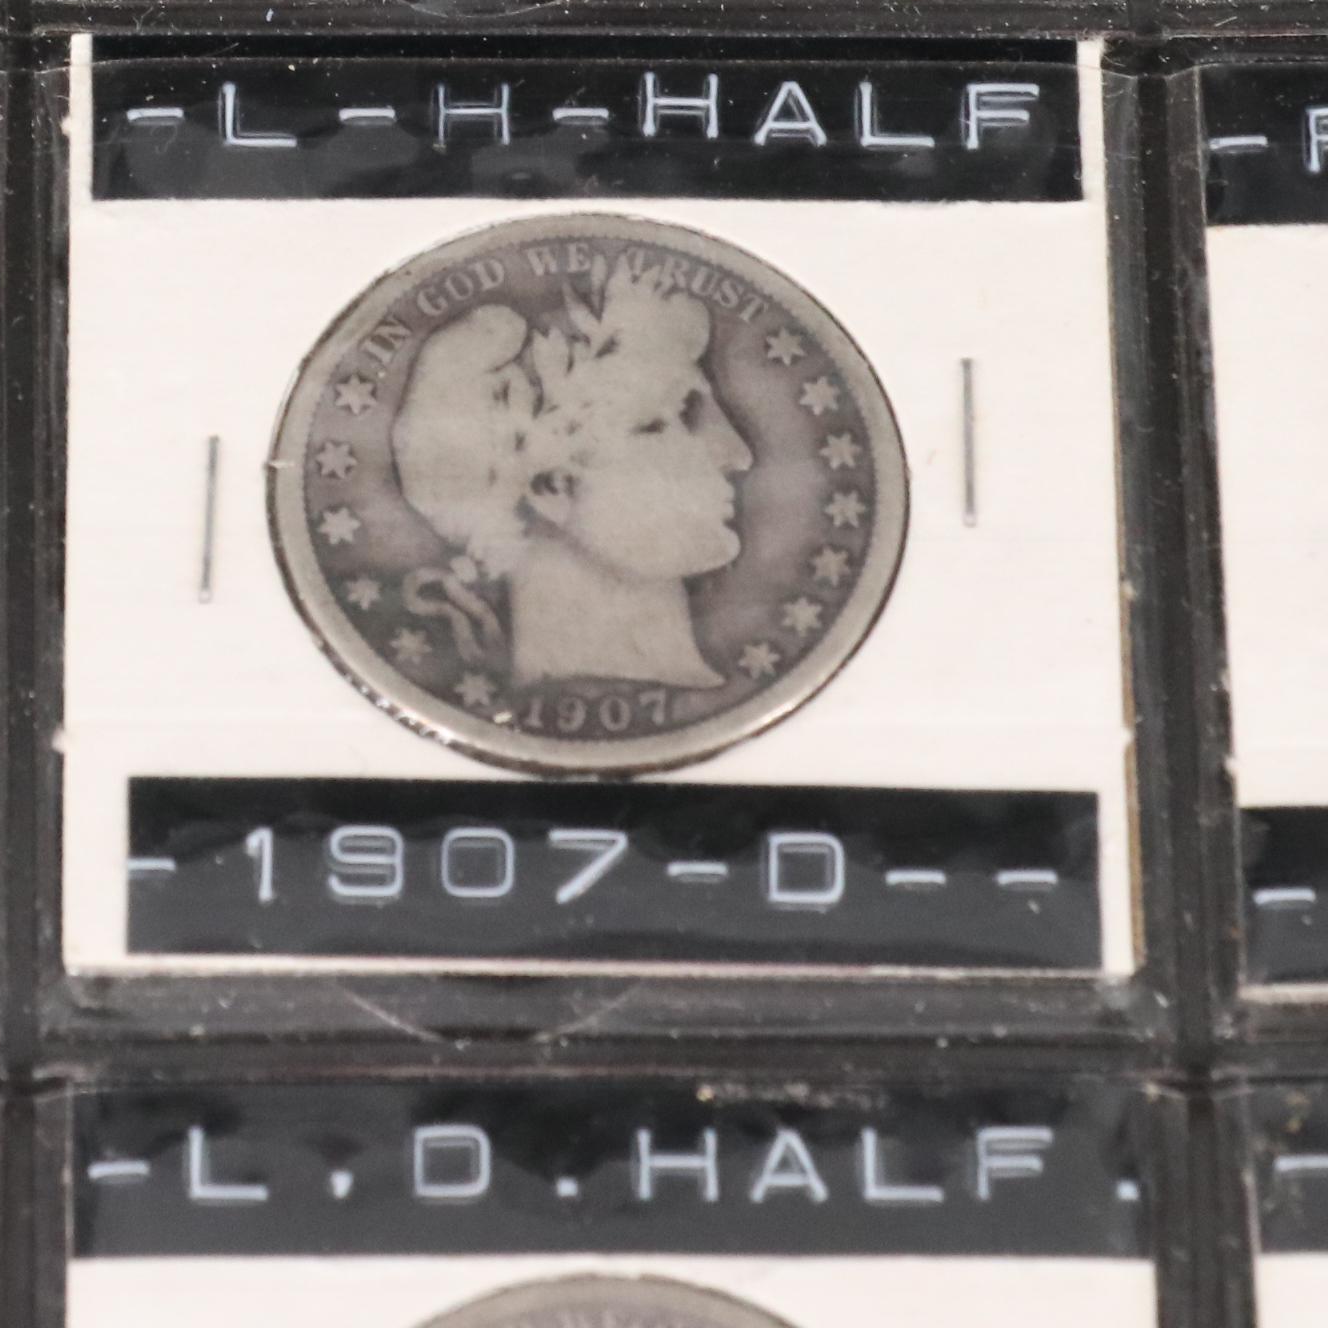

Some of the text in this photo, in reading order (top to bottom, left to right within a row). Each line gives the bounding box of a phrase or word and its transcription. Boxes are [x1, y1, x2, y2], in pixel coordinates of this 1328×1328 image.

[362, 313, 414, 368] IN
[416, 257, 506, 317] GOD
[527, 242, 592, 277] WE
[524, 691, 667, 732] 1907
